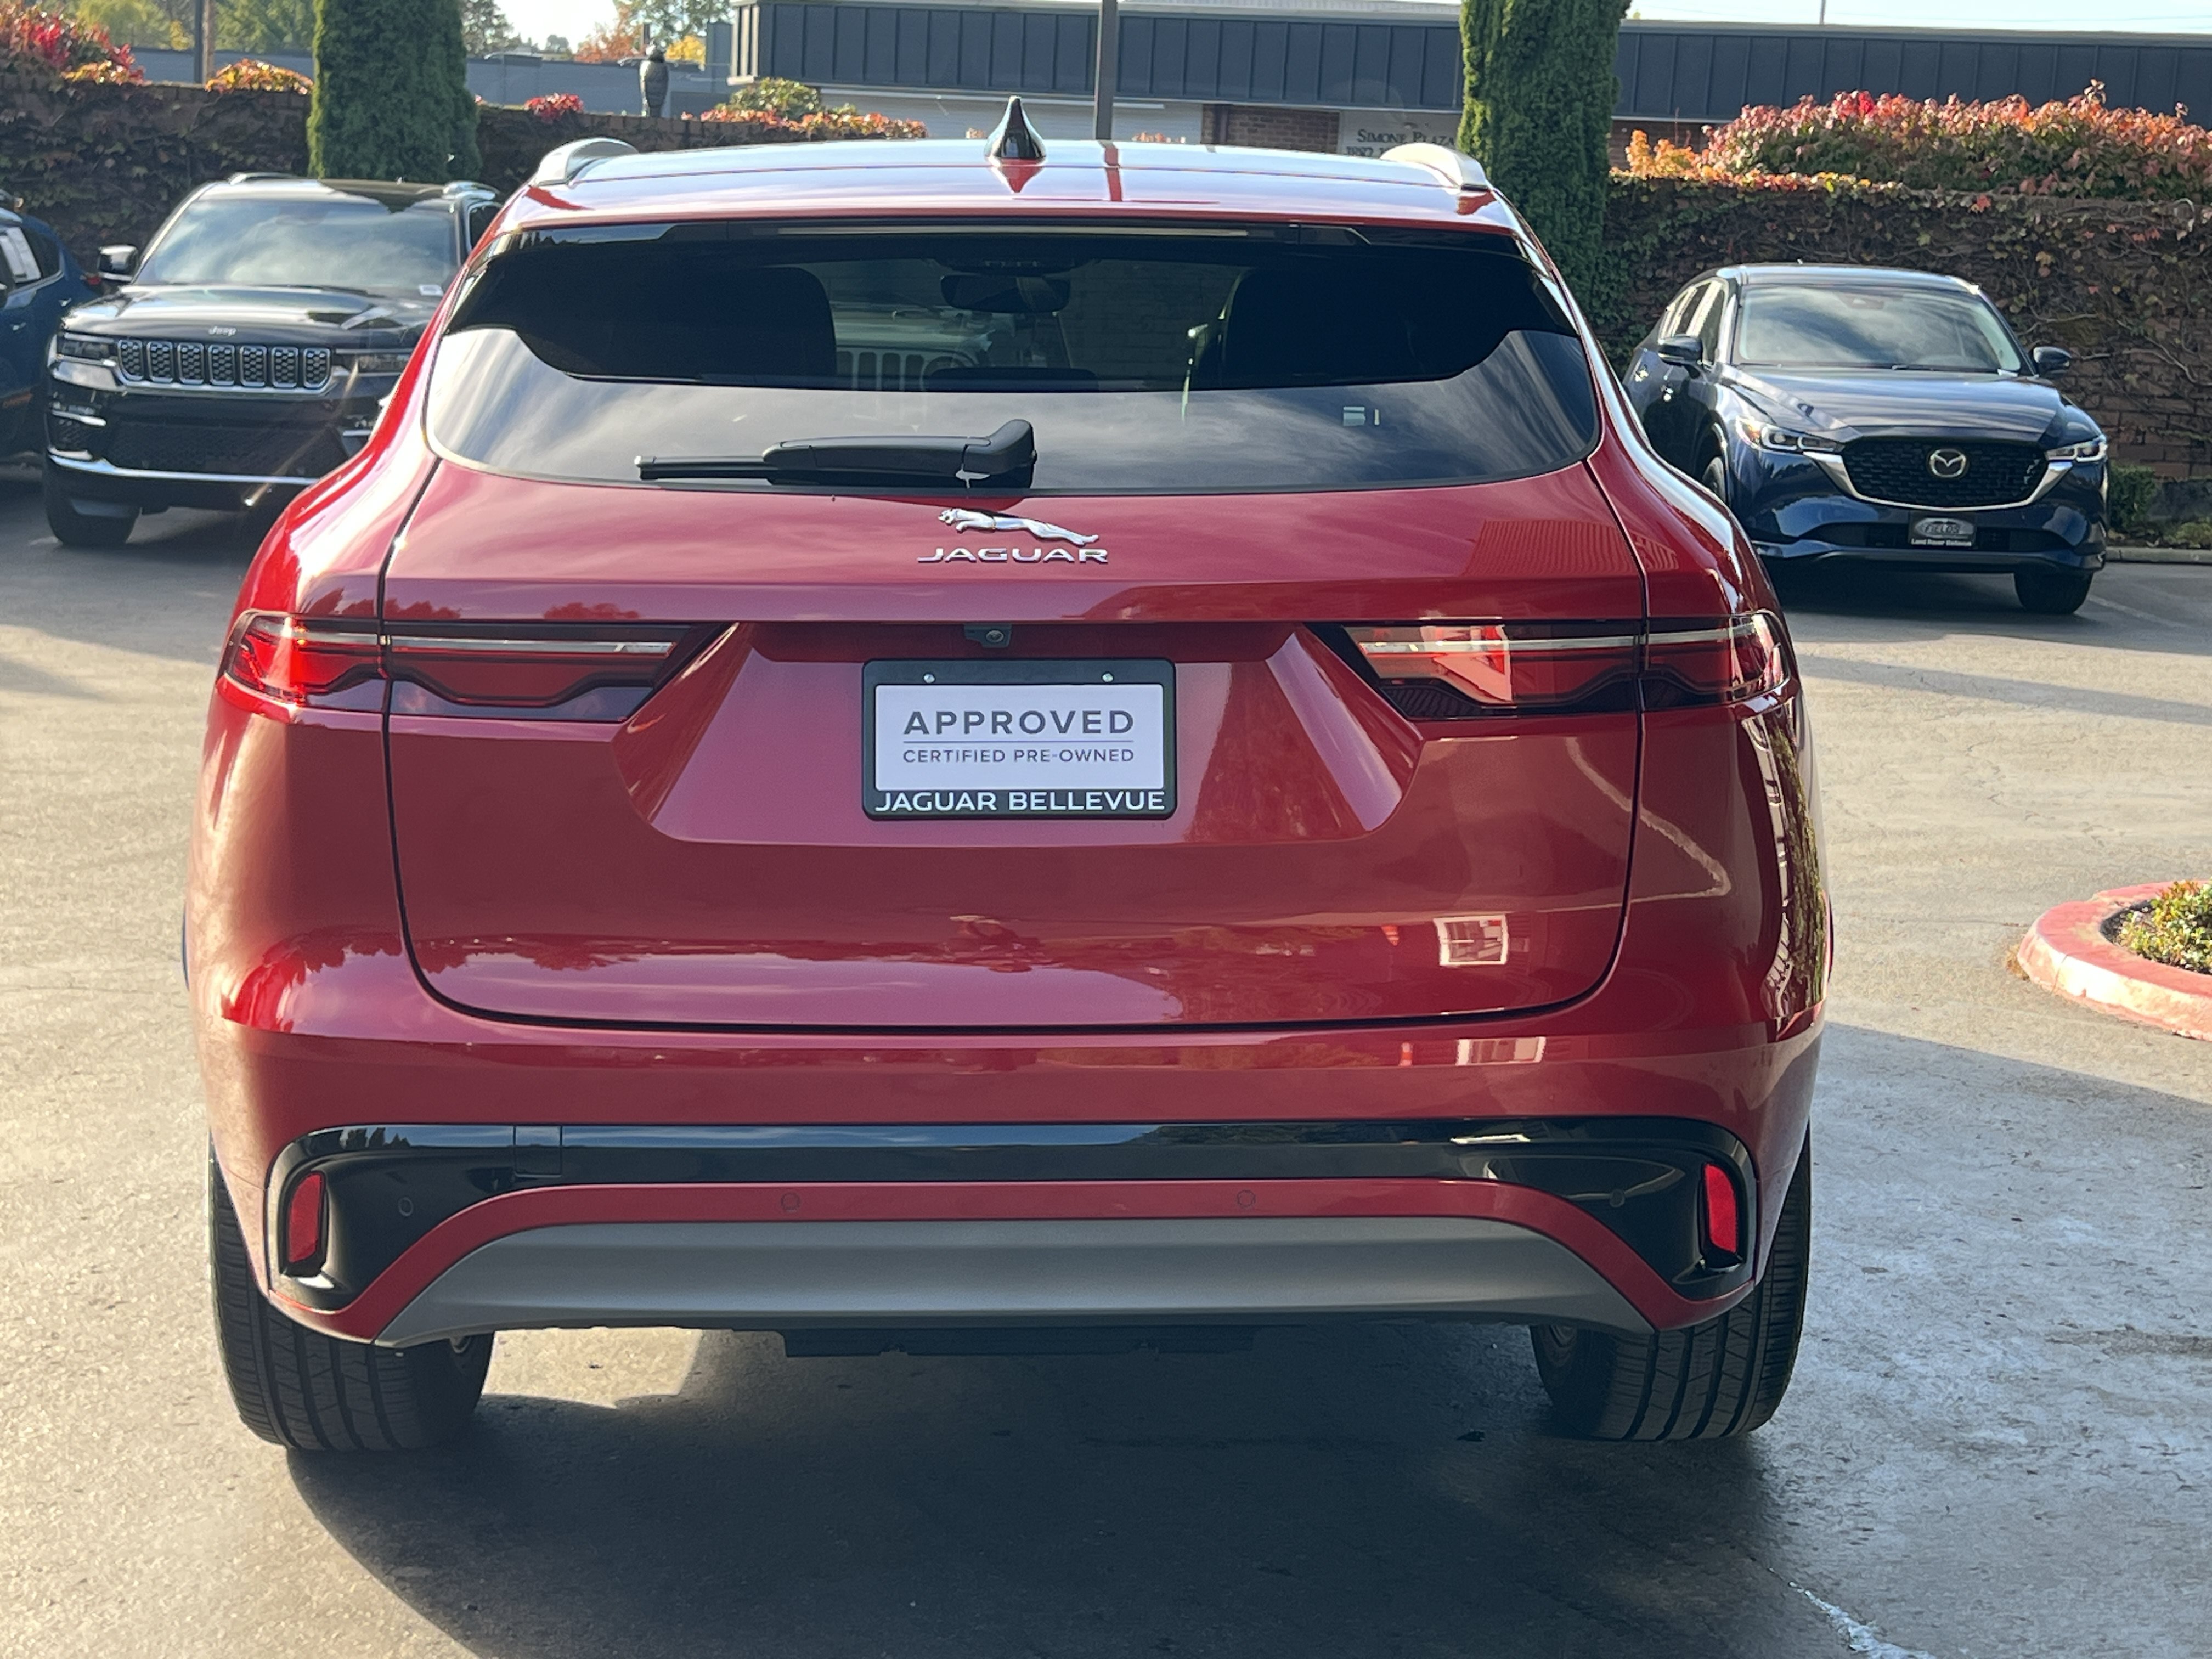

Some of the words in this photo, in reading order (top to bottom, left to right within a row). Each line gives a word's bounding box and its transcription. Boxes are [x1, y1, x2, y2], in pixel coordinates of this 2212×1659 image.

[208, 325, 236, 337] Jeep
[917, 548, 1108, 563] JAGUAR
[903, 710, 1134, 735] APPROVED
[903, 749, 1006, 763] CERTIFIED
[1013, 749, 1134, 763] PRE-OWNED
[875, 792, 997, 812] JAGUAR
[1008, 791, 1165, 811] BELLEVUE
